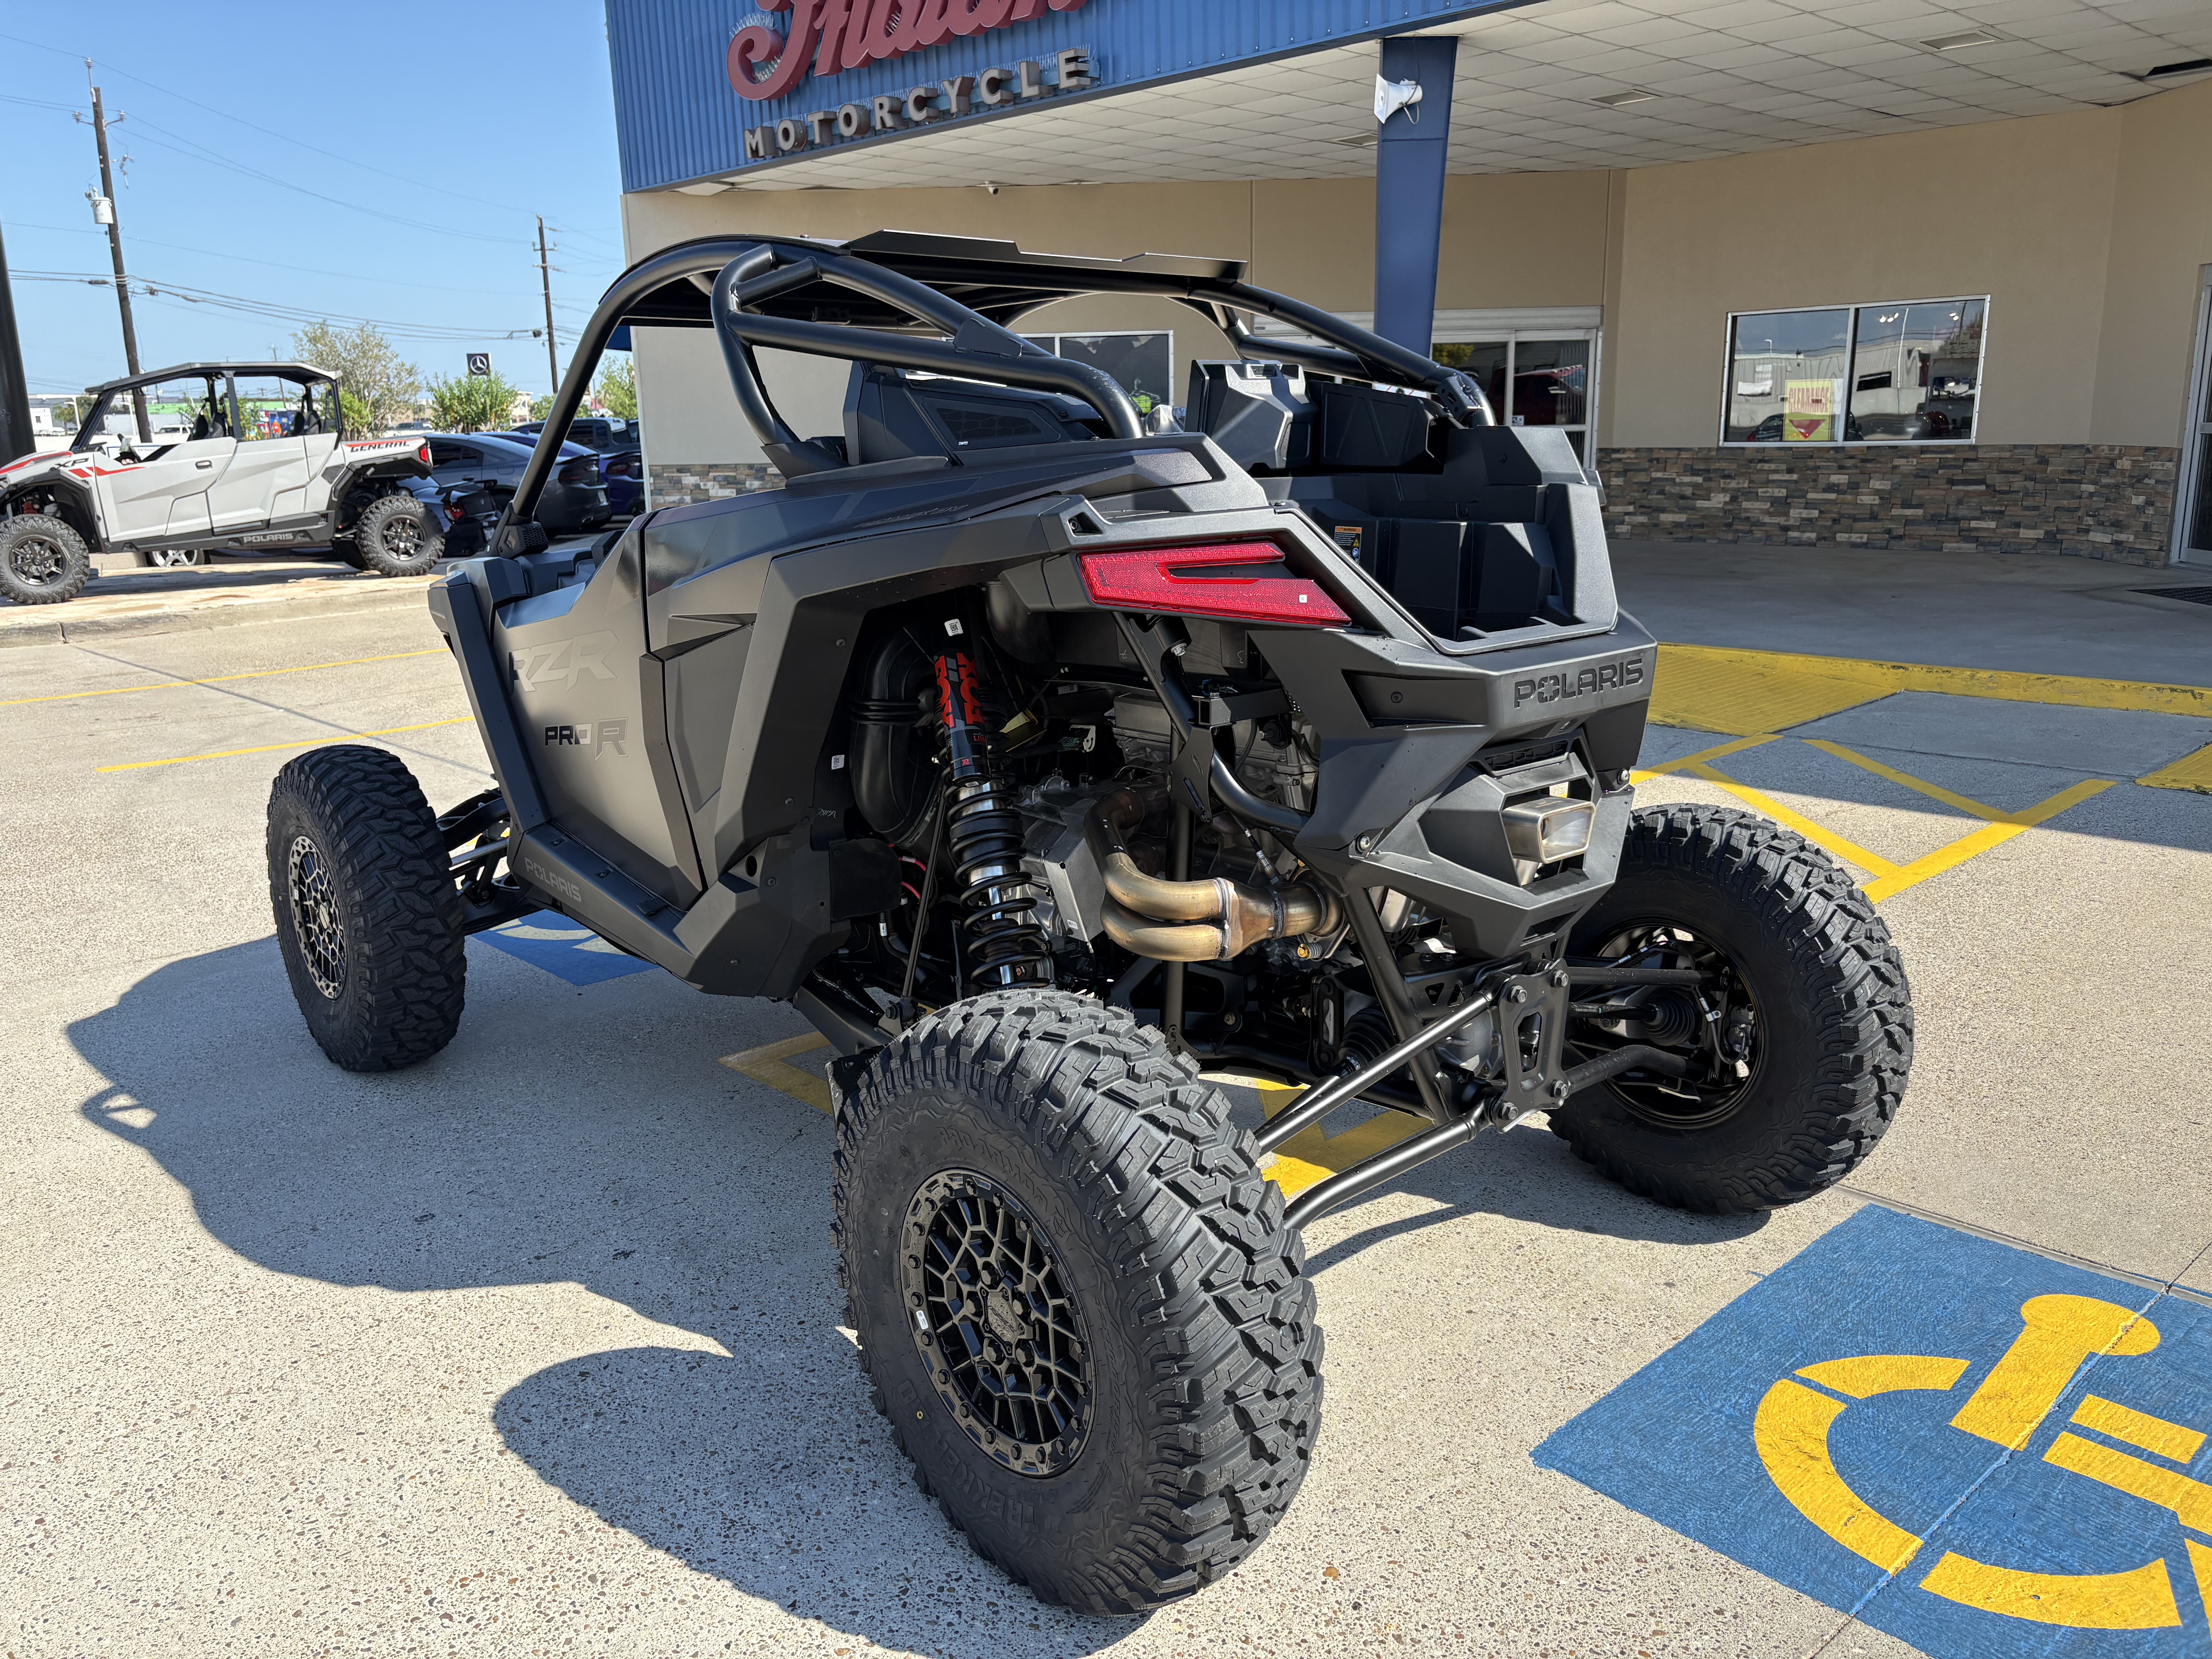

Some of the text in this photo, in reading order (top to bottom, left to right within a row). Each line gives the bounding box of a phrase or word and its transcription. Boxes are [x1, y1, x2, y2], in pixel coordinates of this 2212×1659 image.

[744, 48, 1091, 159] MOTORCYCLE
[1788, 386, 1830, 413] CLEARANCE
[54, 457, 89, 469] XP
[350, 441, 409, 453] GENERAL
[243, 533, 294, 543] POLARIS
[508, 629, 619, 697] RZR
[1514, 658, 1643, 709] POLARIS
[544, 717, 629, 762] PRO R
[524, 857, 582, 902] POLARIS
[935, 1430, 1040, 1534] TREKKER
